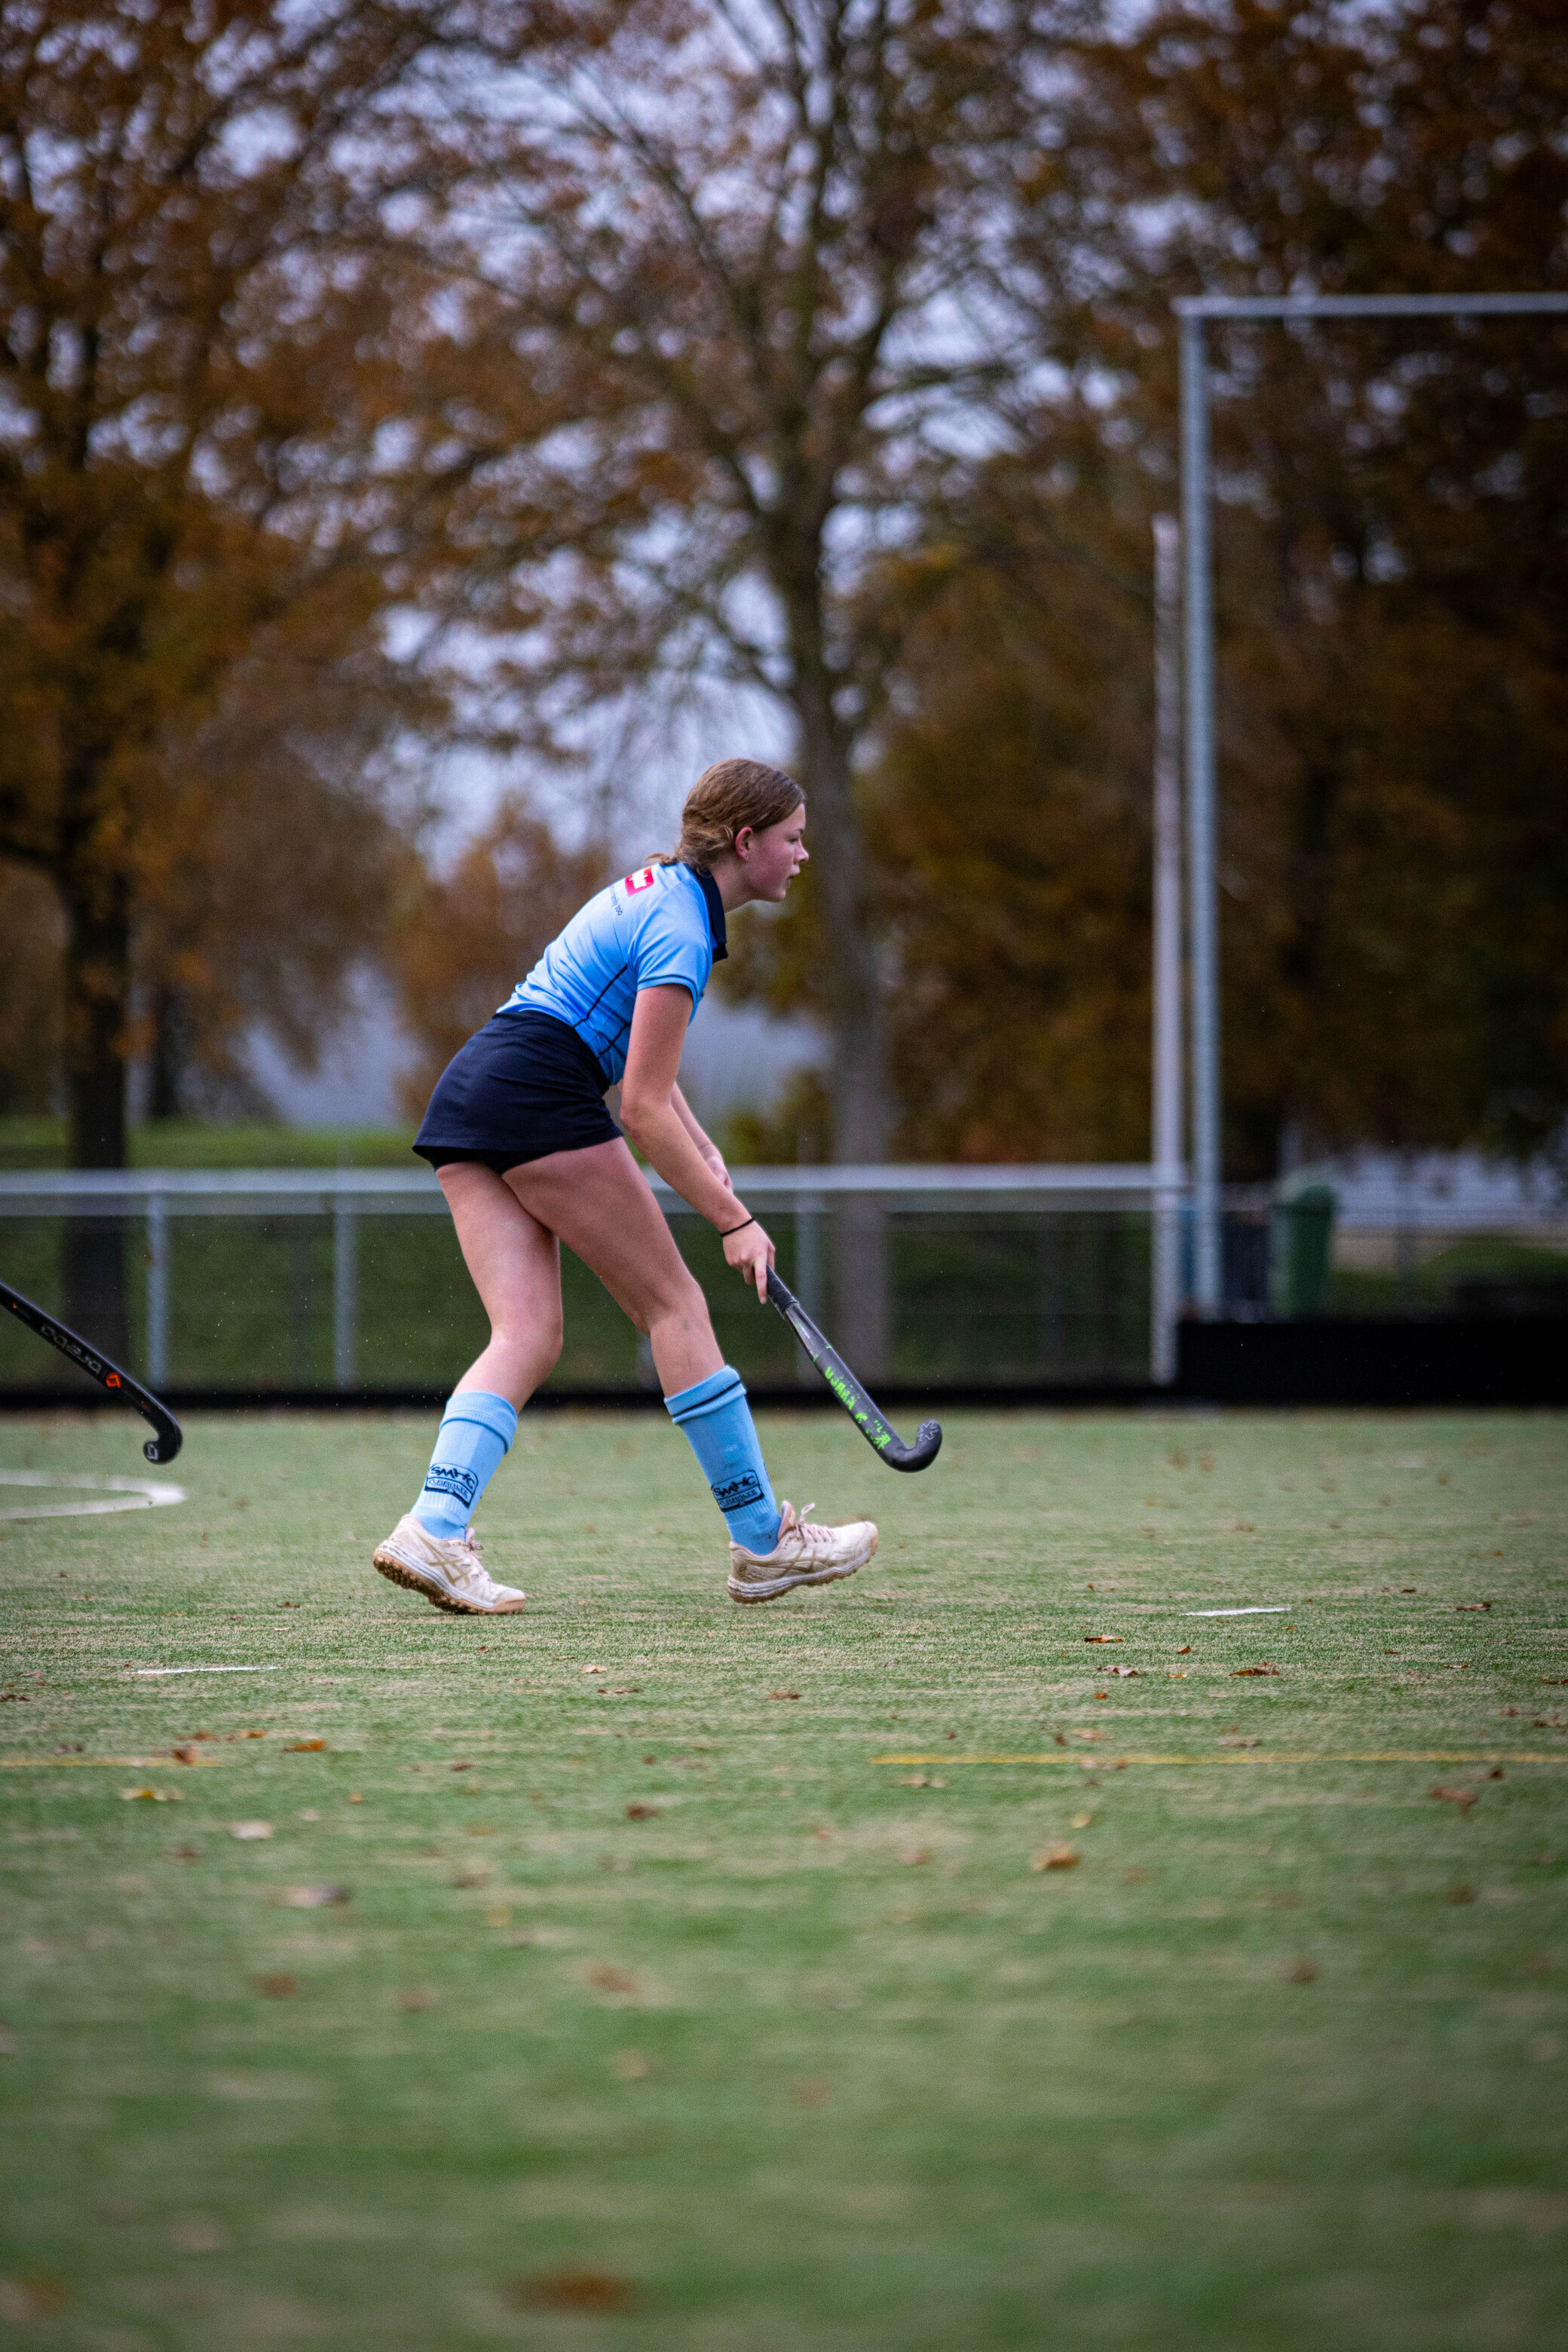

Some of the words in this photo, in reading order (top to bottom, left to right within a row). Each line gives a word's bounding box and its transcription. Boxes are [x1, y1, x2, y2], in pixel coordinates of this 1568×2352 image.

[614, 905, 623, 916] too
[430, 1466, 475, 1490] SMHC
[713, 1475, 755, 1497] SMHC
